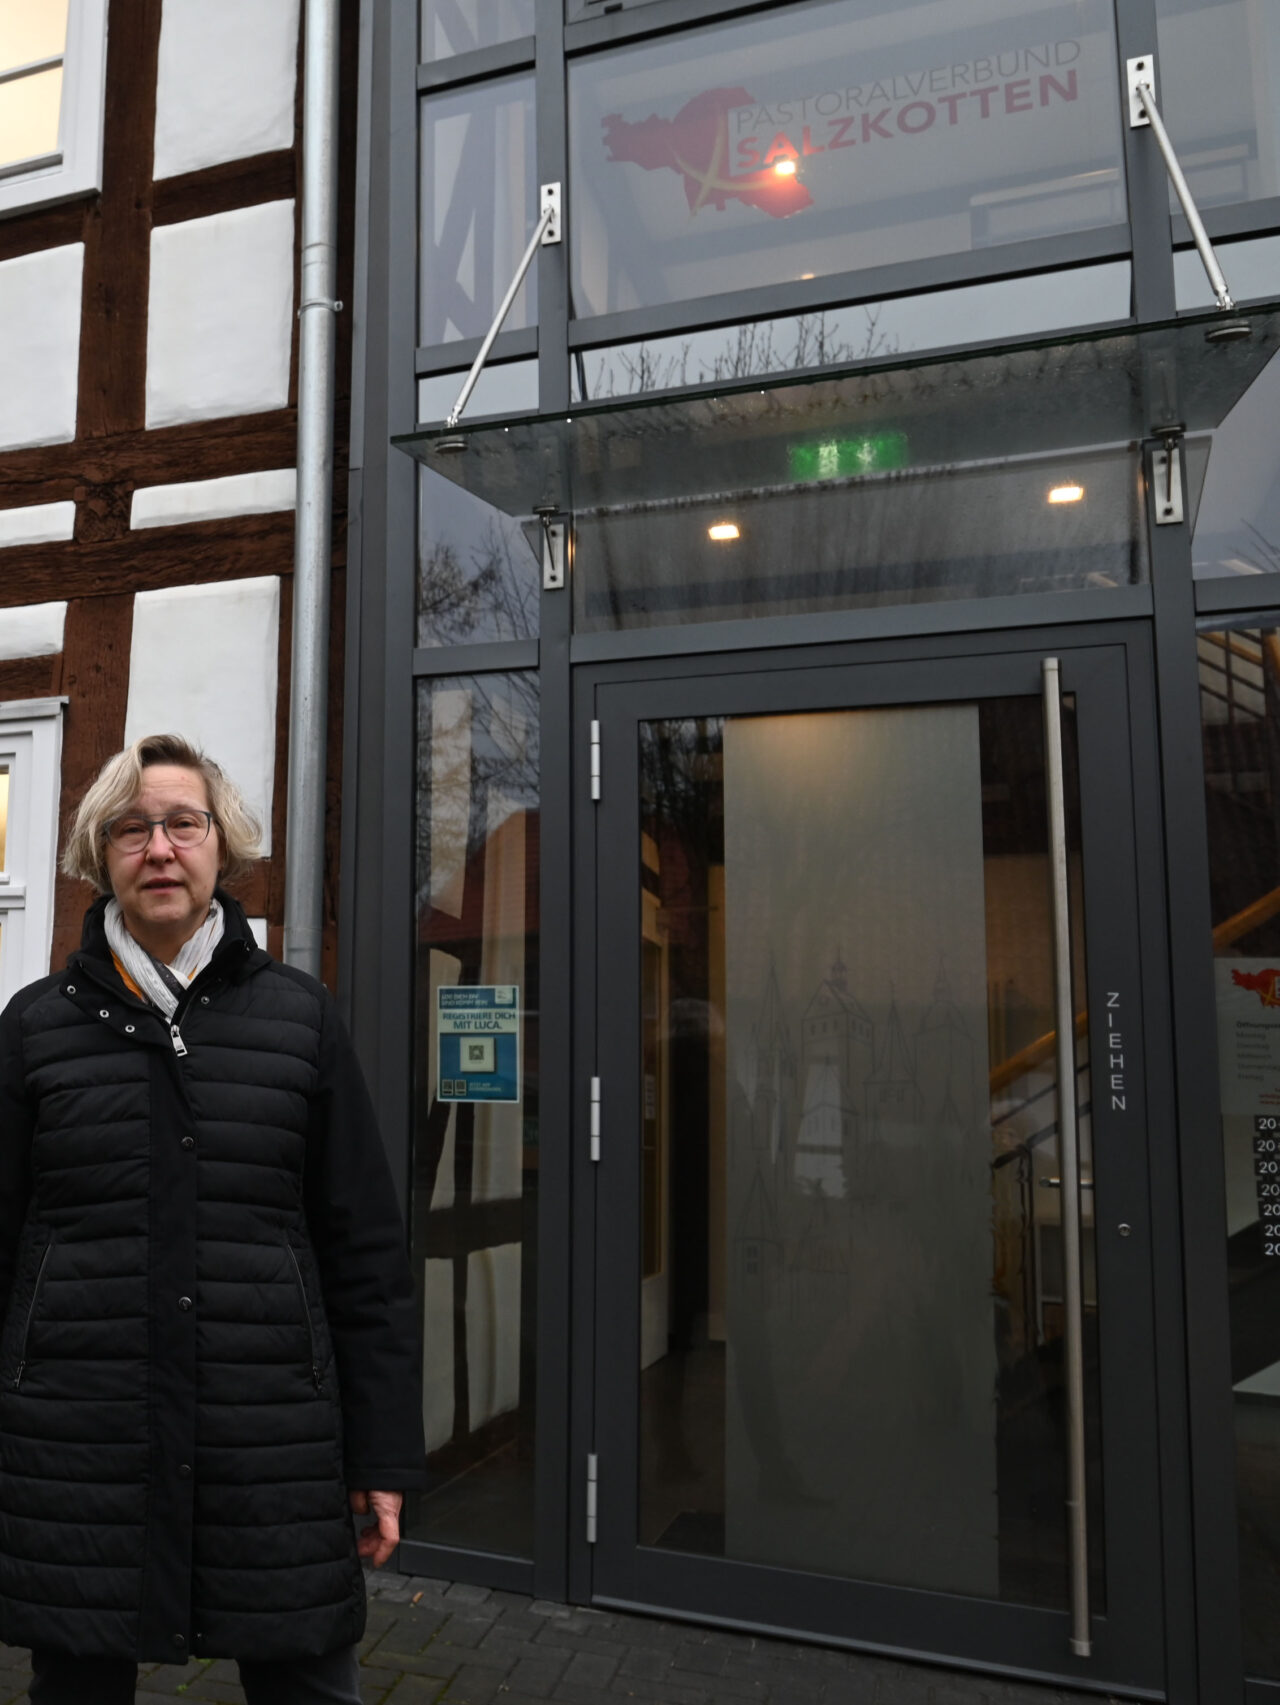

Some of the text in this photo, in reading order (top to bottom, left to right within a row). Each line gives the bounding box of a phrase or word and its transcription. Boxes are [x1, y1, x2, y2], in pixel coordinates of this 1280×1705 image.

[736, 39, 1081, 135] PASTORALVERBUND
[736, 68, 1080, 169] SALZKOTTEN
[442, 1012, 516, 1020] REGISTRIERE DICH
[453, 1021, 502, 1030] MIT LUCA.
[1106, 991, 1126, 1111] ZIEHEN
